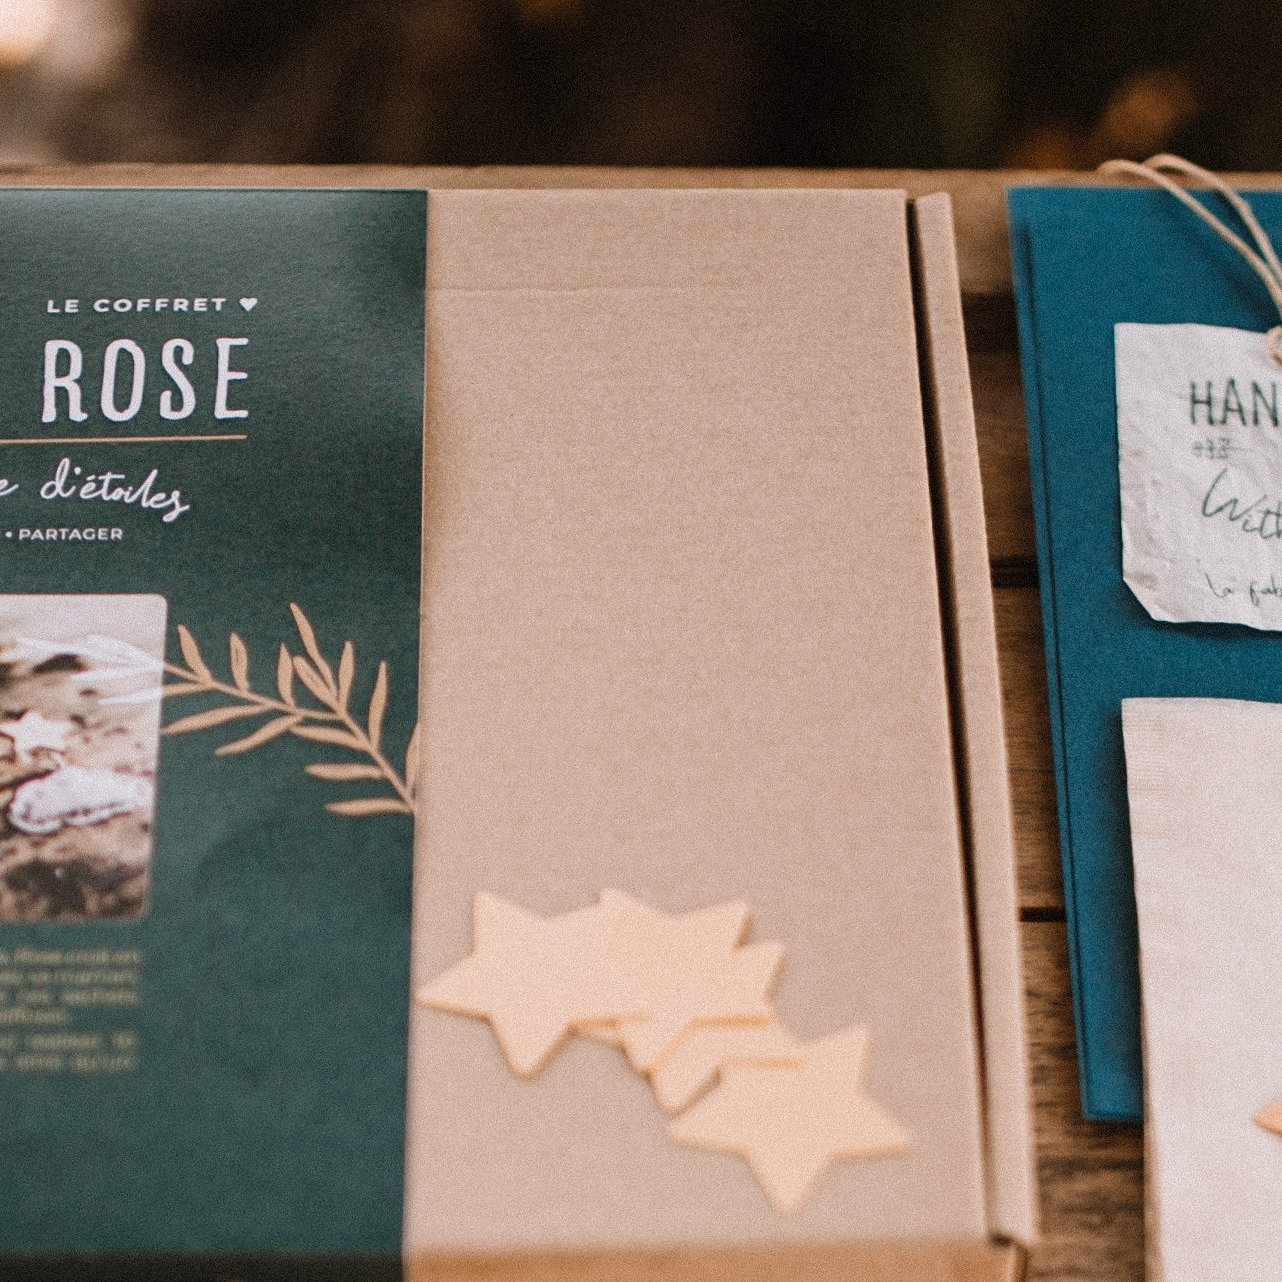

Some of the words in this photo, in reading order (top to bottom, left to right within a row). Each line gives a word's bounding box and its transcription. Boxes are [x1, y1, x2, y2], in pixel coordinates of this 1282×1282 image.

[46, 298, 80, 314] LE
[92, 297, 227, 313] COFFRET
[41, 336, 250, 423] ROSE
[39, 456, 191, 523] d'étoiles
[17, 527, 124, 542] PARTAGER
